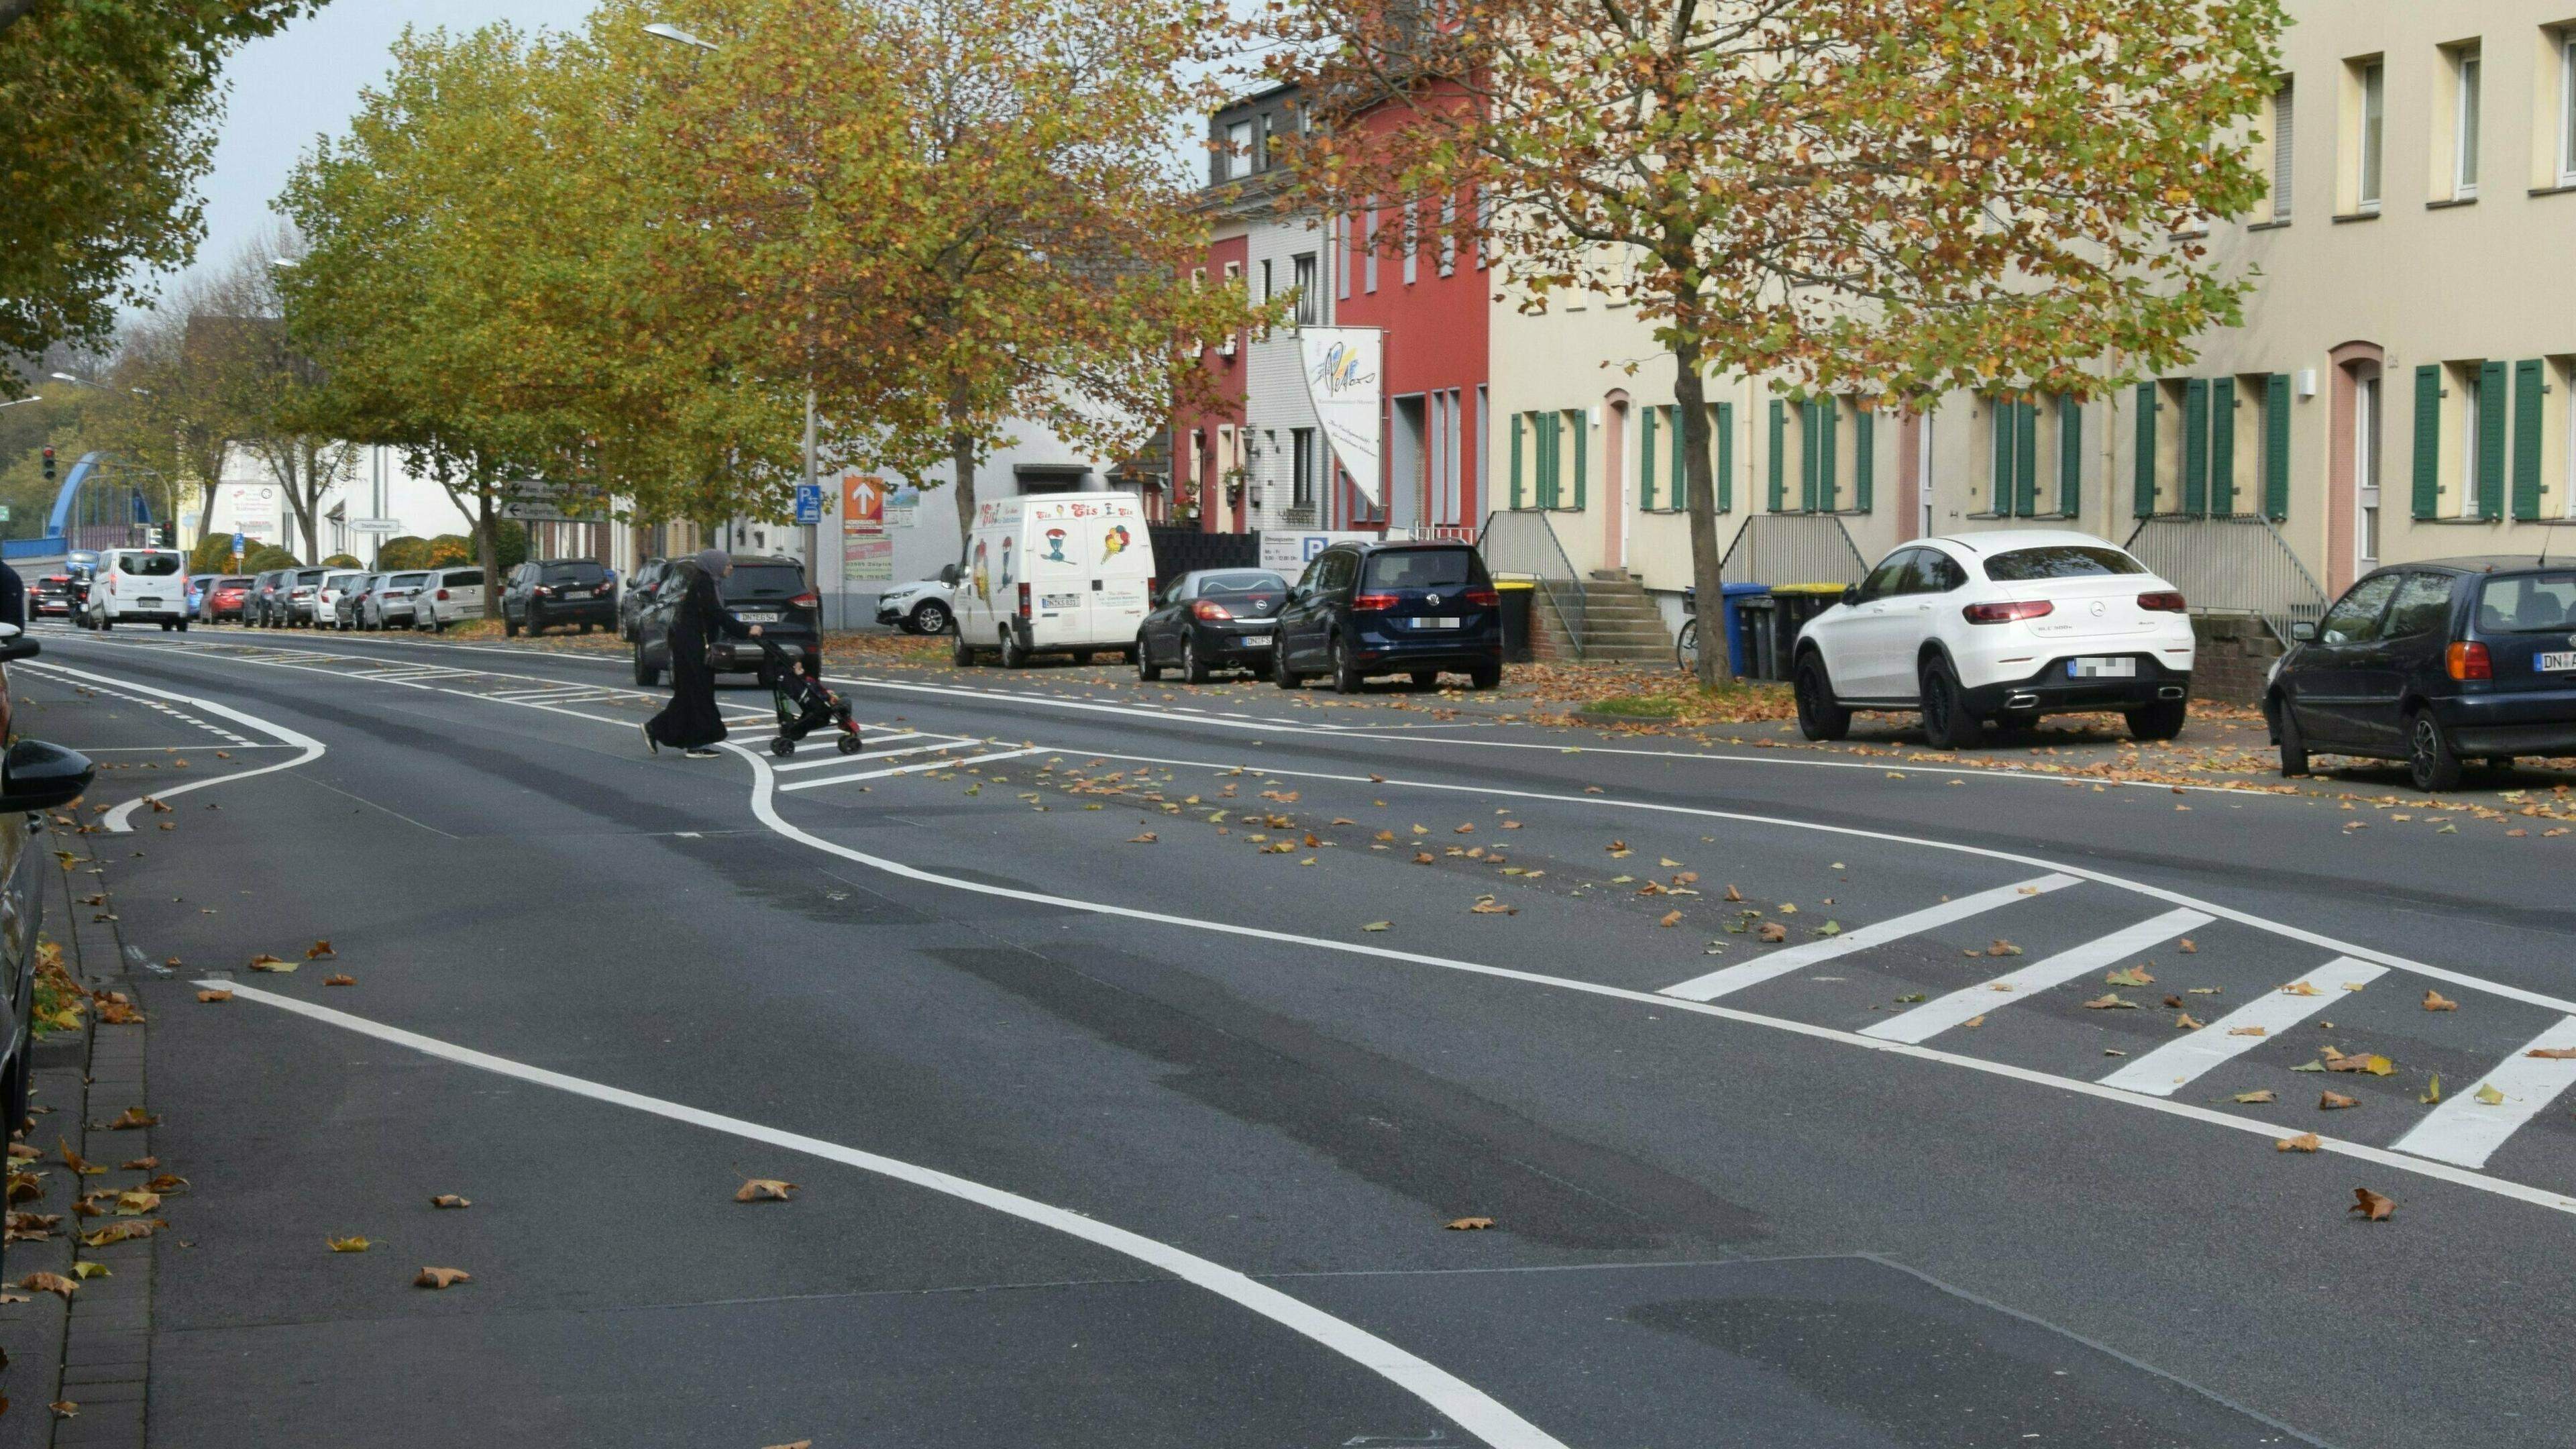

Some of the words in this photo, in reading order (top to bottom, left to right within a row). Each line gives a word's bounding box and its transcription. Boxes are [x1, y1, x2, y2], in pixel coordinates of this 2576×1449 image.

[800, 488, 811, 503] P
[1071, 503, 1098, 518] Eis
[1309, 540, 1324, 560] P
[2544, 654, 2562, 668] DN
